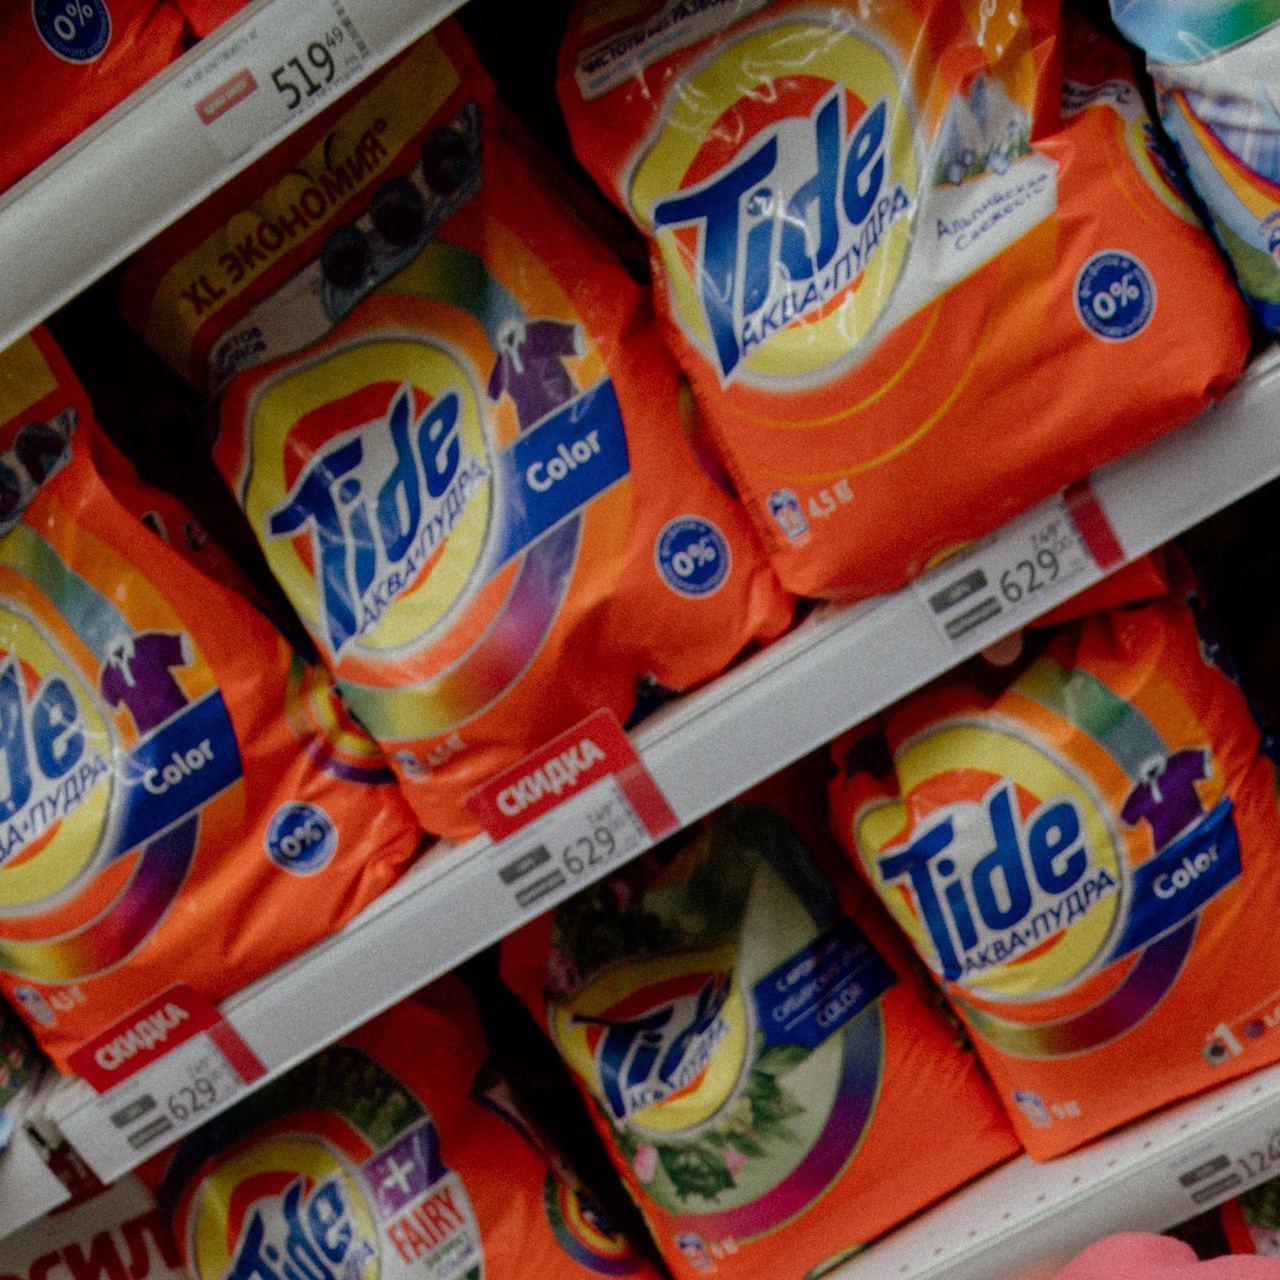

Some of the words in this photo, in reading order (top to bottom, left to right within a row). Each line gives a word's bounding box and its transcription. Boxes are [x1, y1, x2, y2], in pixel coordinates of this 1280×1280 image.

[53, 0, 94, 41] 0%
[270, 41, 336, 110] 519
[325, 26, 345, 49] 49
[655, 95, 886, 377] Tide
[181, 276, 226, 314] XL
[1093, 273, 1139, 318] 0%
[526, 429, 601, 493] Color
[270, 390, 461, 655] Tide
[673, 541, 717, 578] 0%
[1001, 549, 1061, 602] 629
[142, 739, 214, 794] Color
[496, 737, 606, 817] СКИДКА
[279, 820, 324, 858] 0%
[563, 827, 617, 876] 629
[879, 786, 1088, 981] Tide
[1153, 846, 1219, 899] Color
[94, 1003, 190, 1070] СКИДКА
[167, 1078, 217, 1122] 629
[387, 1186, 465, 1265] FAIRY
